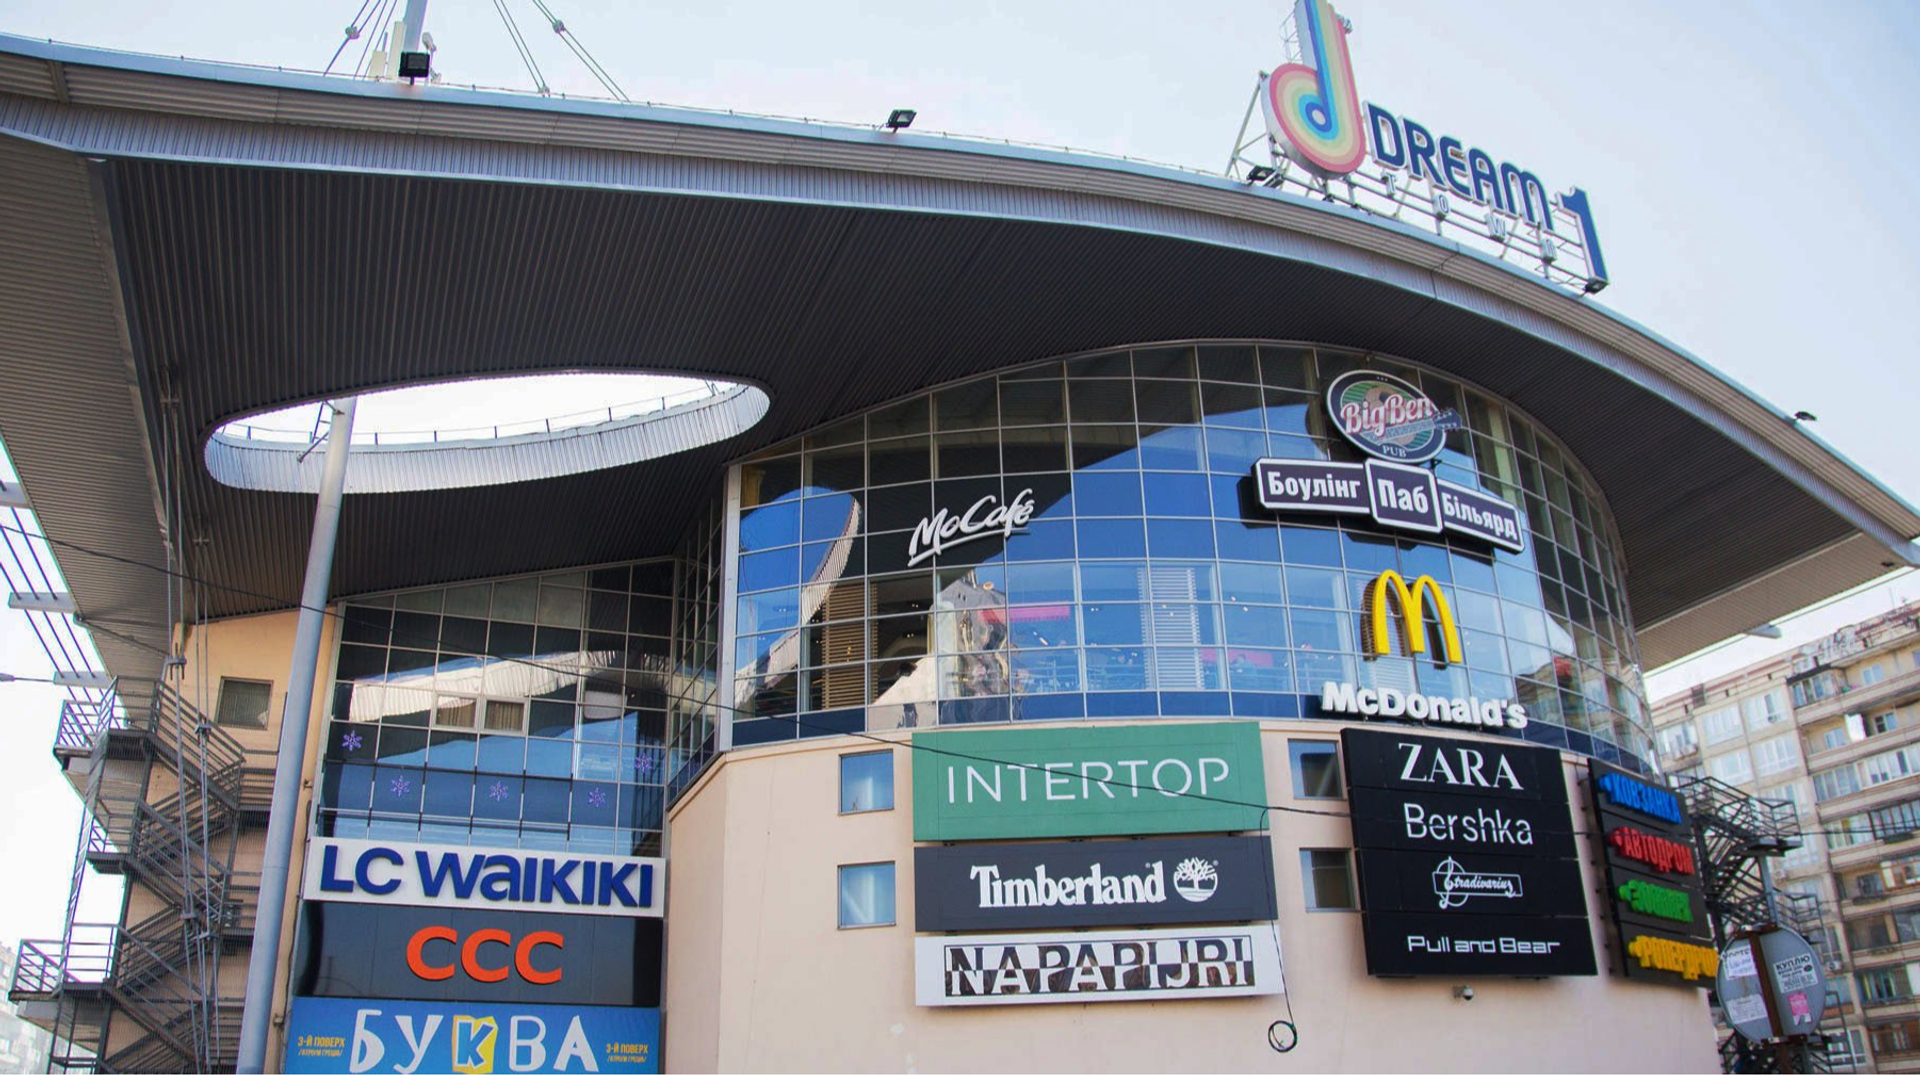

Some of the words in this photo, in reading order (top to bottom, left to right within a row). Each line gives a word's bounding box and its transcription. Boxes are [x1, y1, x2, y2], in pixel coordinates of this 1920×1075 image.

[1364, 101, 1553, 232] DREAM
[1381, 444, 1407, 459] PUB
[1267, 470, 1361, 502] Боулінг
[1376, 478, 1429, 515] Паб
[1441, 491, 1518, 542] Більярд
[1321, 680, 1529, 729] McDonald's
[947, 757, 1230, 805] INTERTOP
[1397, 742, 1524, 791] ZARA
[1403, 802, 1534, 846] Bershka
[320, 844, 404, 896] LC
[1620, 827, 1695, 875] АВТОДРОМ
[970, 860, 1167, 909] Timberland
[947, 937, 1249, 996] NAPAPIJRI
[1407, 934, 1451, 953] Pull
[1454, 938, 1496, 954] and
[1498, 936, 1561, 955] Bear
[1637, 935, 1720, 981] РОЛЕРДРО
[1775, 955, 1811, 971] КУПЛЮ
[314, 1036, 346, 1047] ПОВЕРХ
[620, 1043, 649, 1054] ПОВЕРХ
